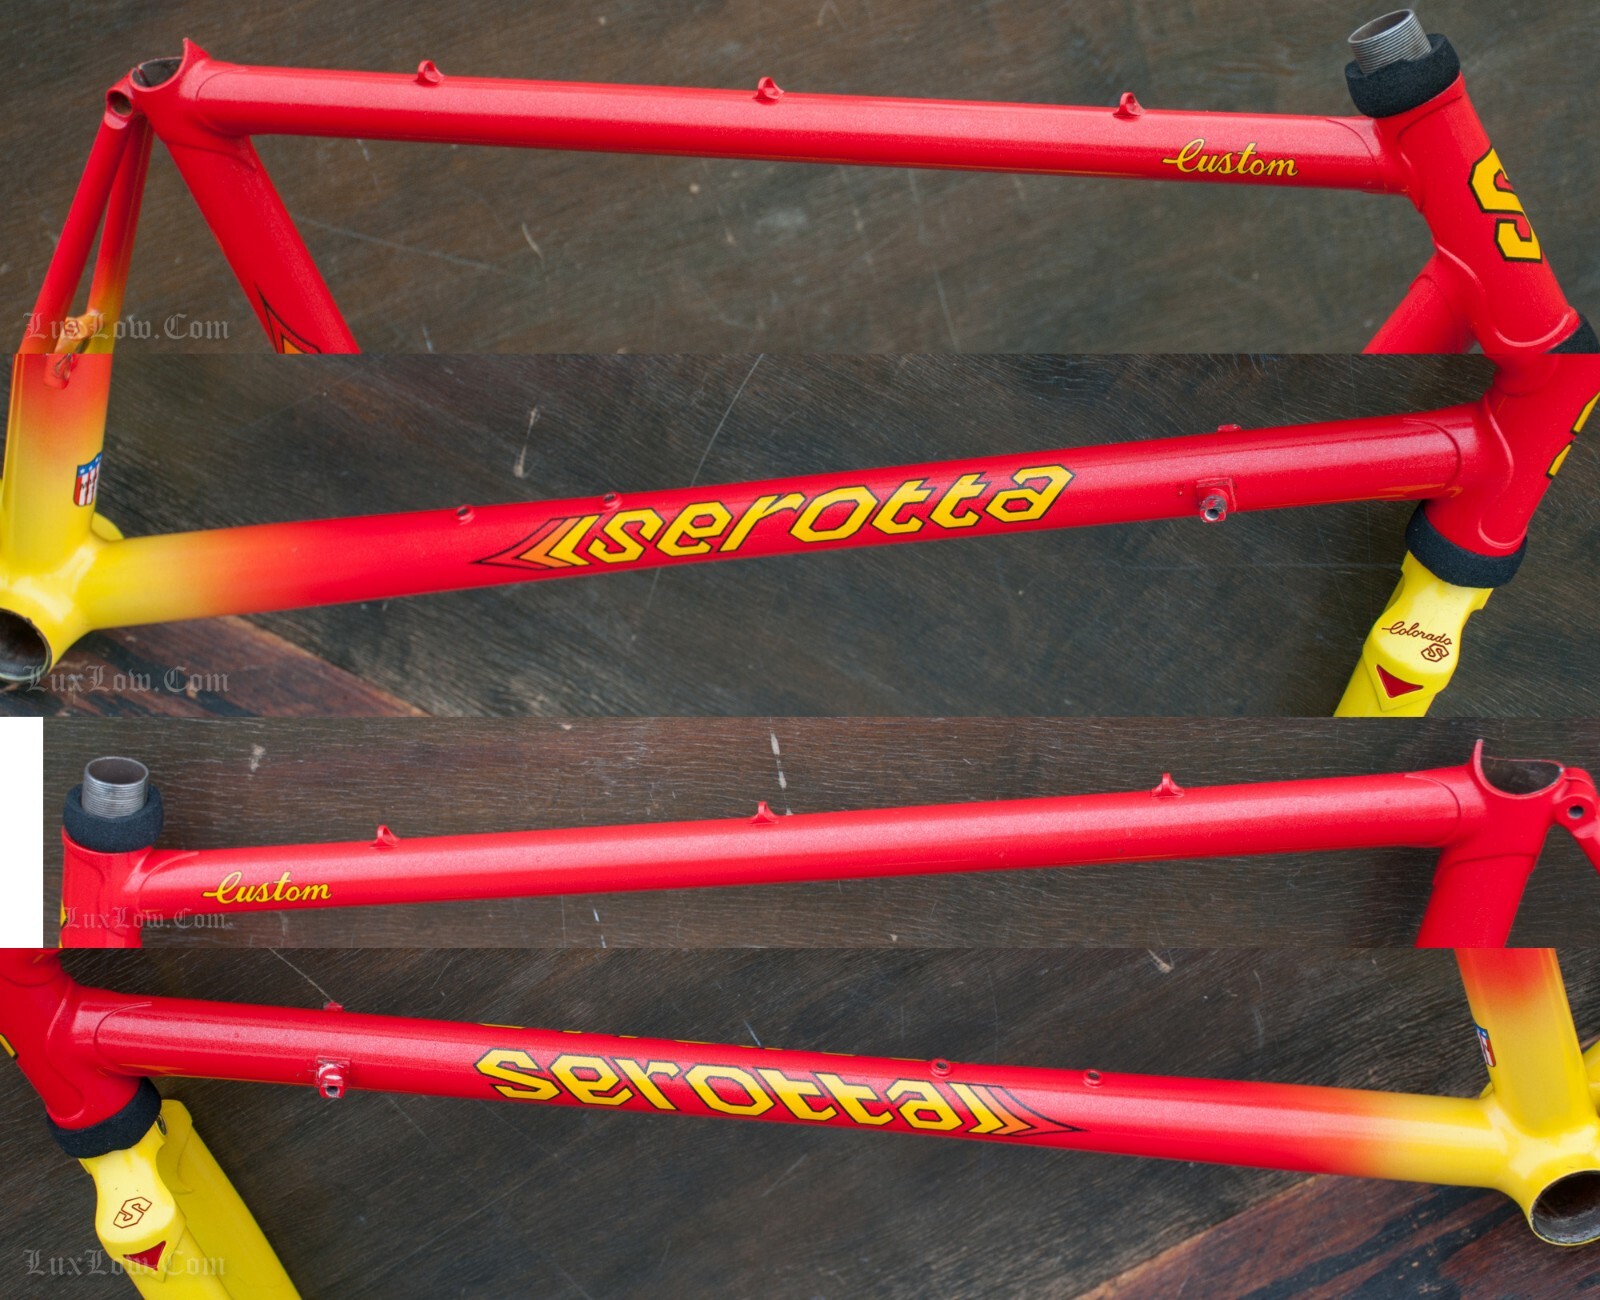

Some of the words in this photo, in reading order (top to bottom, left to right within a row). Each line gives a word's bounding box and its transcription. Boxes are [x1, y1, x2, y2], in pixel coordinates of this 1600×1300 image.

[1162, 138, 1299, 177] Custom
[1381, 621, 1452, 645] Colorado
[202, 870, 332, 904] Custom
[113, 1196, 152, 1229] S
